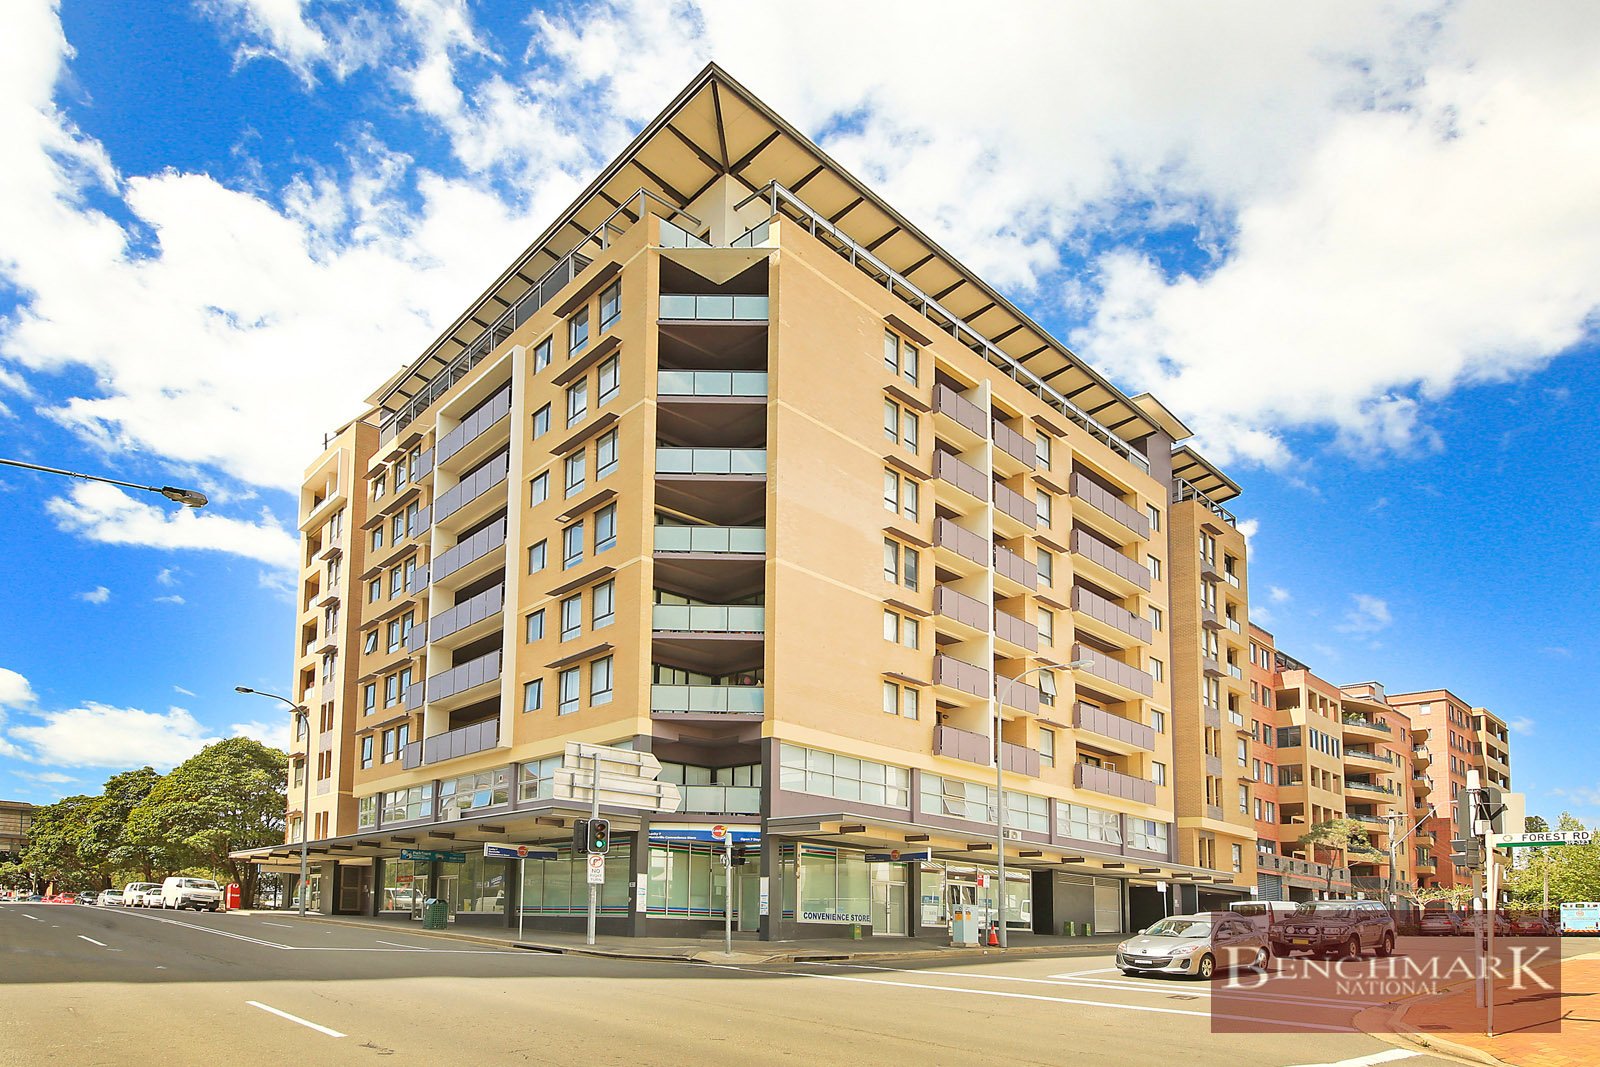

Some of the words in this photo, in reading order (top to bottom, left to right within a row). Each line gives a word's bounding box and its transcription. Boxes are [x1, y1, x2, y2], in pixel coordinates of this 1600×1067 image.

[1522, 832, 1567, 841] FOREST
[1573, 831, 1589, 840] RD
[803, 912, 849, 921] CONVENIENCE
[850, 914, 870, 922] STORE
